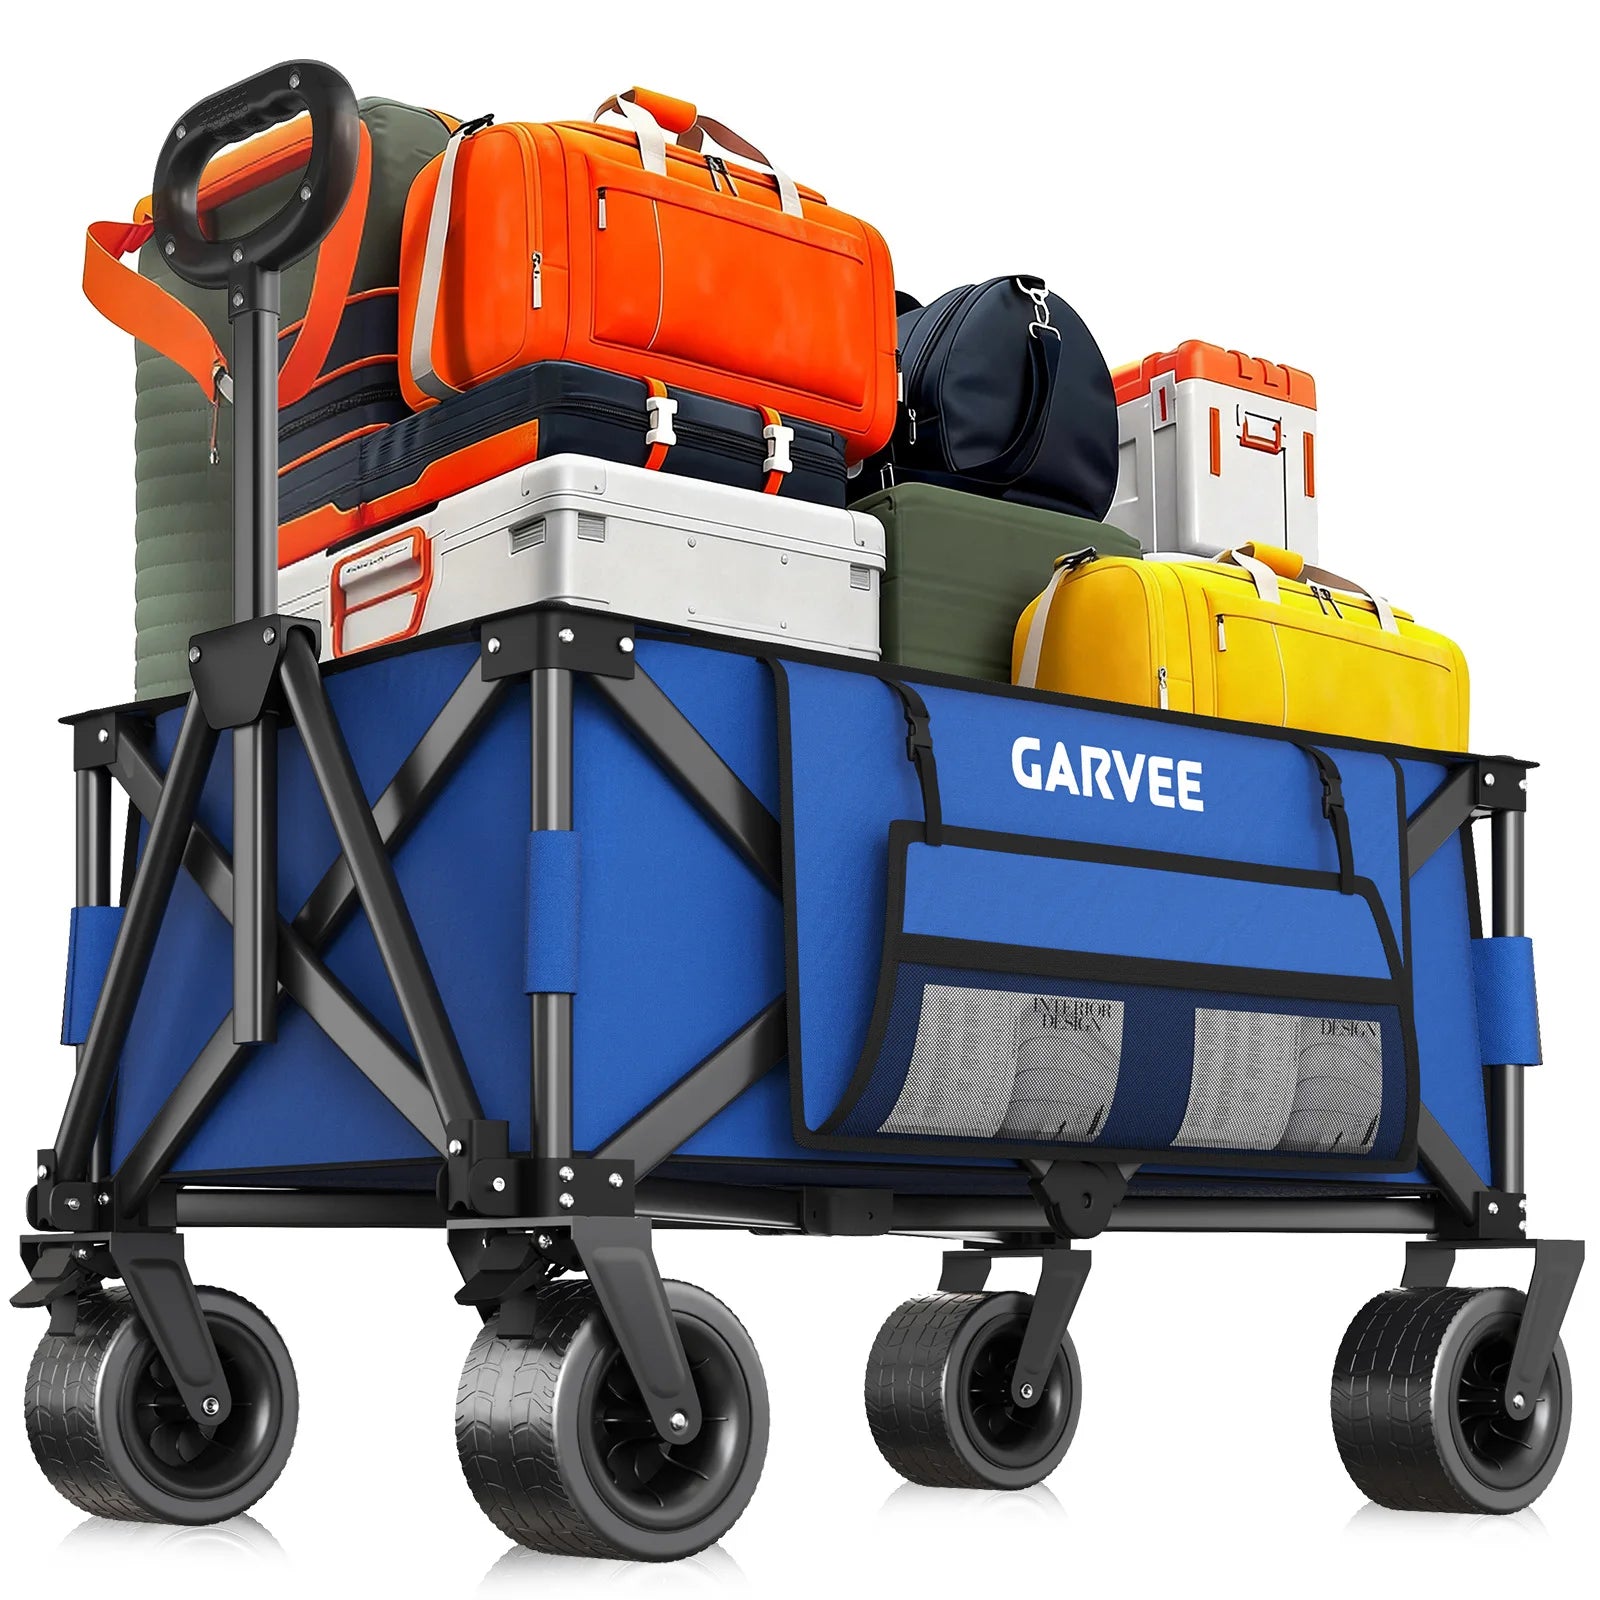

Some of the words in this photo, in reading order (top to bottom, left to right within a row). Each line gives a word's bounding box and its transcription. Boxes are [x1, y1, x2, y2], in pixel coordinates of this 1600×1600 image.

[1012, 736, 1204, 812] GARVEE
[1034, 998, 1112, 1018] INTERIOR
[1043, 1013, 1101, 1032] DESIGN
[1321, 1019, 1376, 1037] DESIGN
